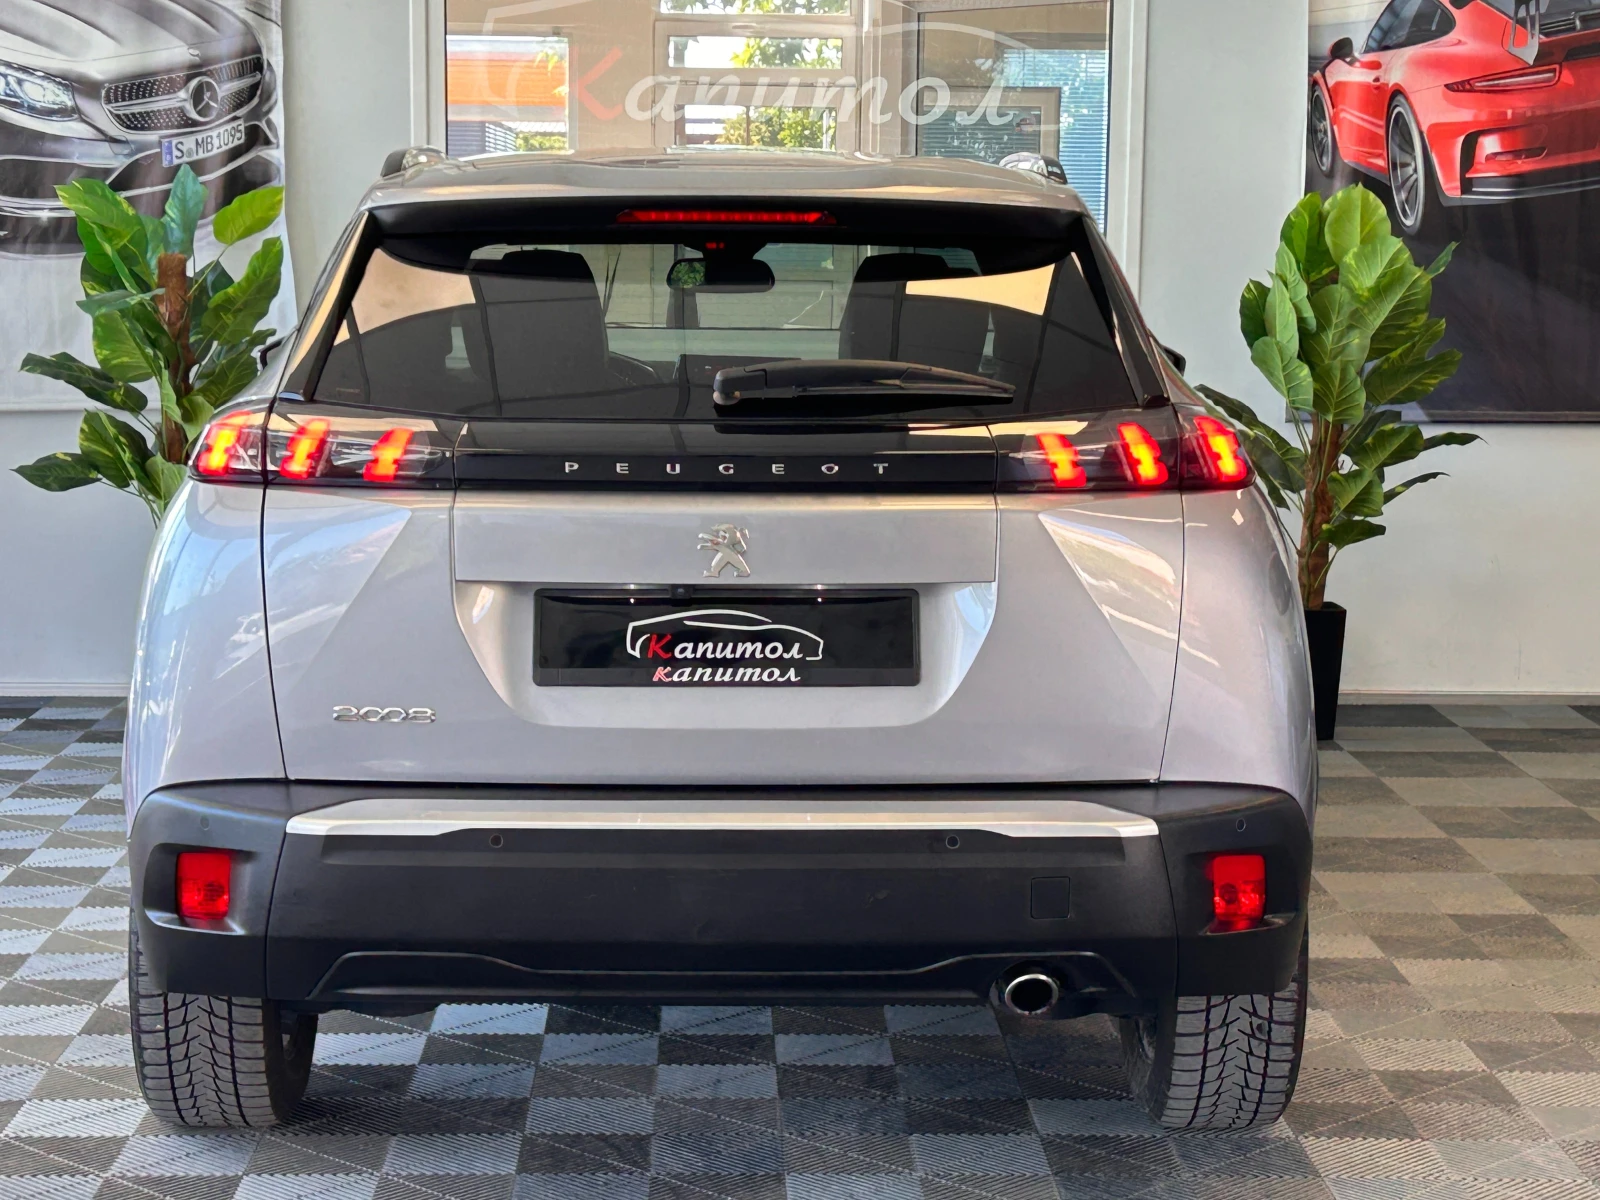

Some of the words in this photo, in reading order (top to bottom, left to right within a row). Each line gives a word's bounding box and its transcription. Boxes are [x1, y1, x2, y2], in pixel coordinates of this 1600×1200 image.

[561, 47, 1015, 125] Капитол
[175, 141, 185, 159] S
[195, 134, 214, 156] MB
[216, 123, 243, 150] 1095
[564, 462, 889, 475] PEUGEOT
[647, 633, 803, 659] Капитол
[332, 705, 436, 723] 2008
